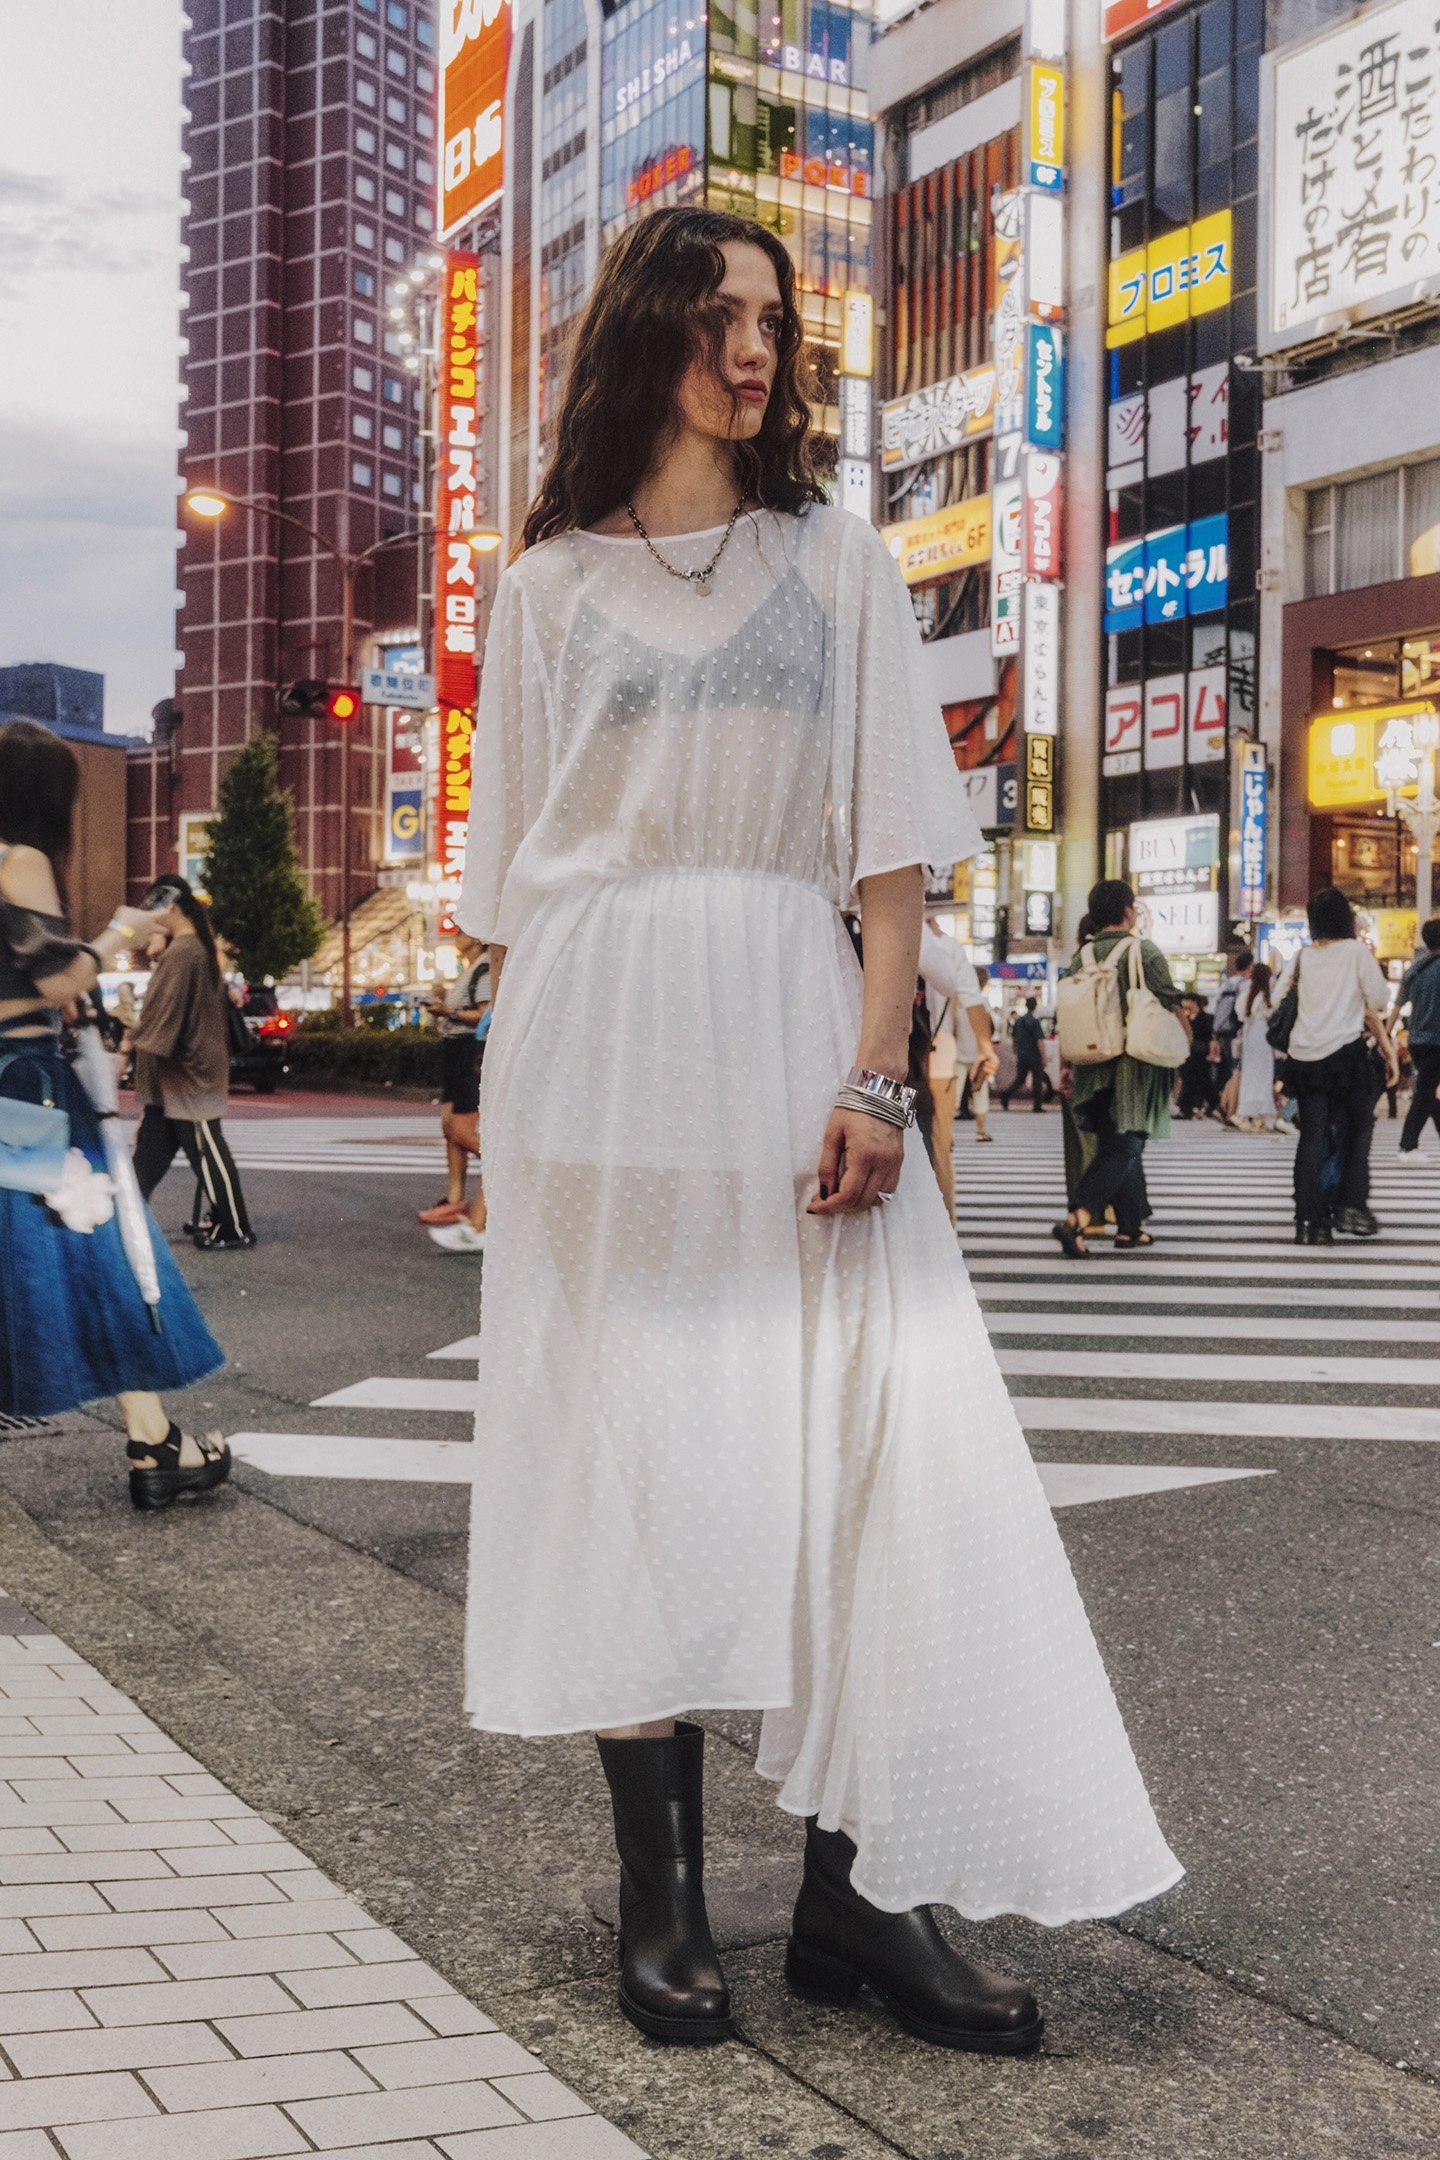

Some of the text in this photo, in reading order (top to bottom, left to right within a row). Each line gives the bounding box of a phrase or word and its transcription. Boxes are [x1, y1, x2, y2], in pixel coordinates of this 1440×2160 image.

[616, 40, 692, 112] SHISHA
[785, 45, 847, 84] BAR
[1038, 78, 1058, 158] プロミス
[1401, 46, 1437, 262] こだわりの
[627, 145, 692, 206] POKER
[1336, 32, 1402, 283] 酒と肴
[1291, 106, 1339, 309] だけの店
[1121, 241, 1229, 315] プロミス
[450, 268, 477, 398] パチンコ
[1036, 339, 1053, 432] セントラル
[967, 524, 987, 549] 6F
[1033, 500, 1052, 557] アコム
[1107, 544, 1228, 607] セントラル
[1109, 686, 1227, 748] アコム
[446, 707, 474, 811] パチンコ
[1244, 774, 1263, 886] じゃんぱら
